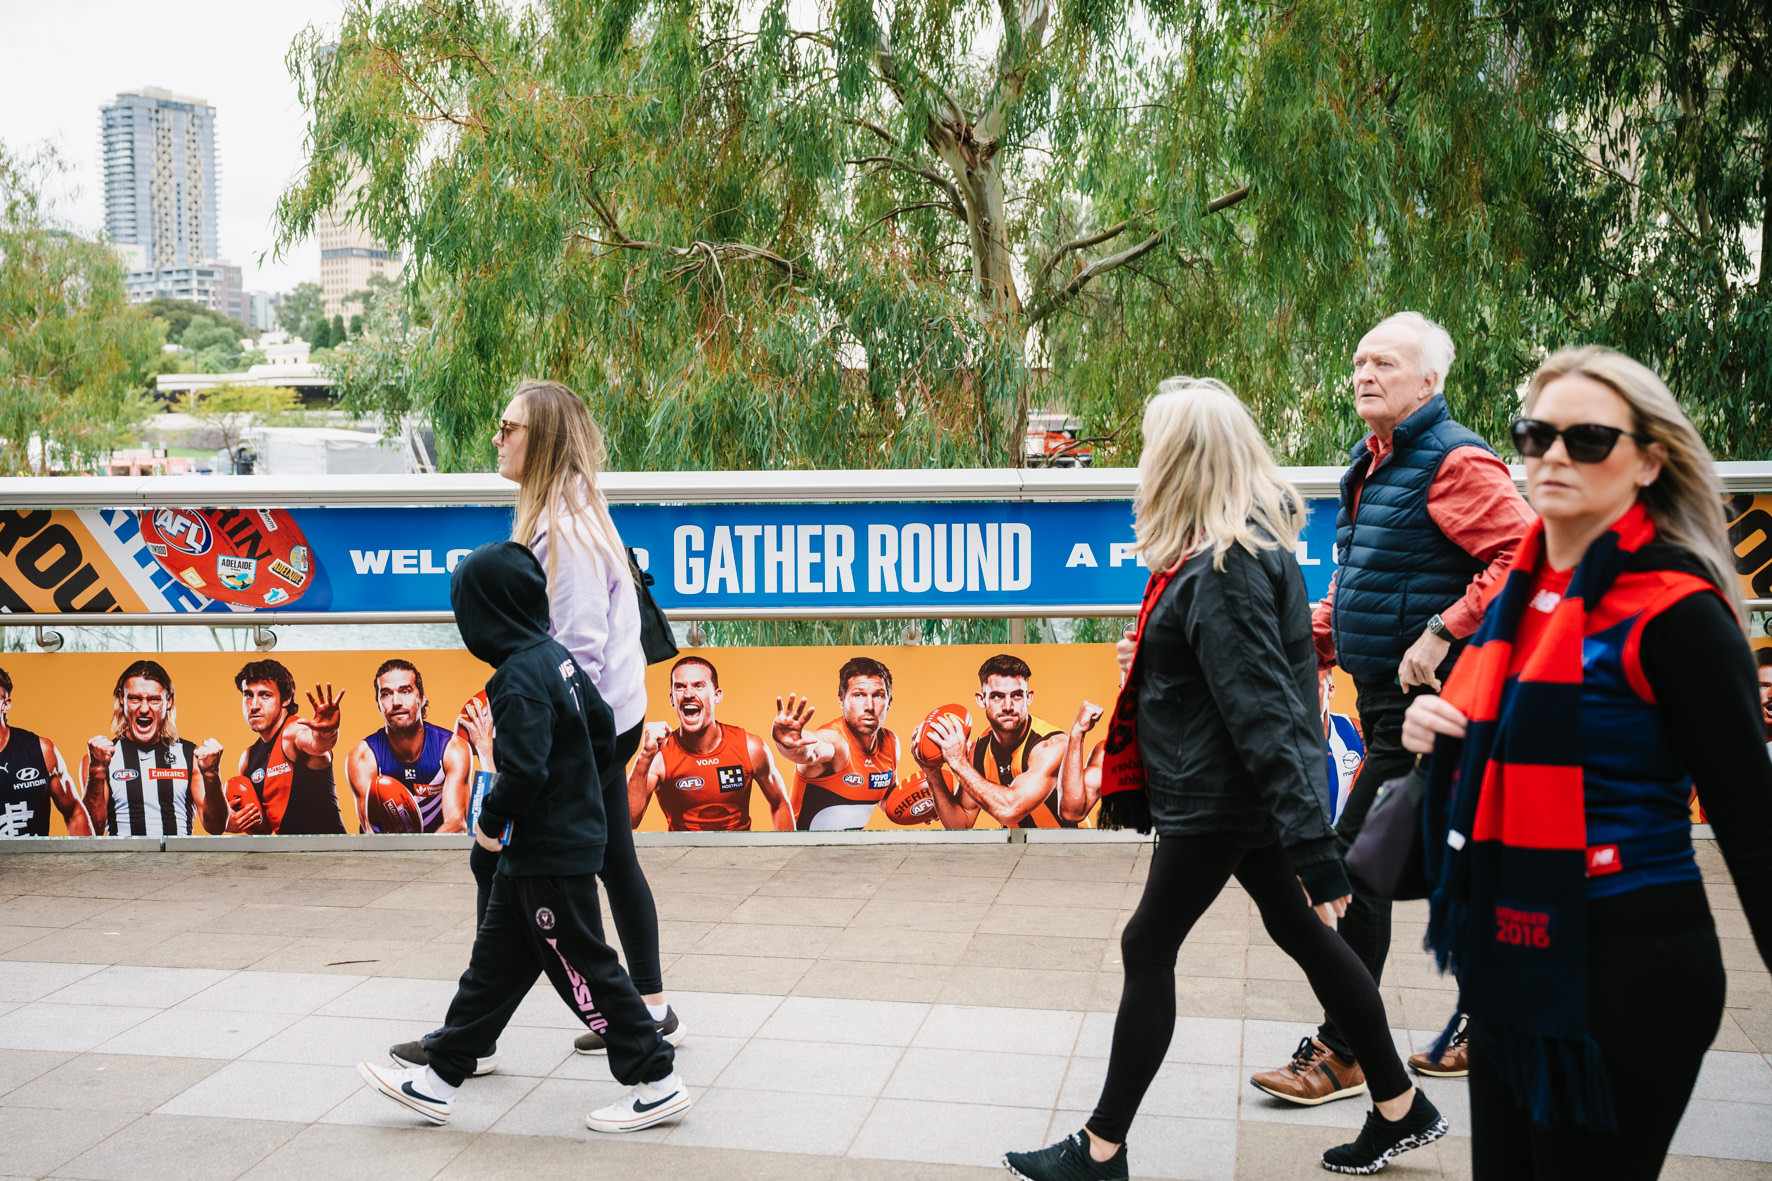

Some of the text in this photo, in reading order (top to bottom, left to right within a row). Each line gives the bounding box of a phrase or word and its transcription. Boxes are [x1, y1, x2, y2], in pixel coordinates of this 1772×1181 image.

[154, 509, 204, 553] AFL
[221, 558, 253, 571] ADELAIDE
[673, 524, 855, 594] GATHER
[868, 522, 1032, 593] ROUND
[1065, 543, 1098, 567] A
[116, 770, 135, 779] AFL
[151, 770, 186, 778] Emirates
[844, 774, 863, 785] AFL
[870, 773, 889, 782] TOYO
[13, 778, 47, 791] HYUNDAI
[679, 777, 702, 789] AFL
[913, 799, 933, 815] AFL
[1496, 920, 1550, 948] 2016
